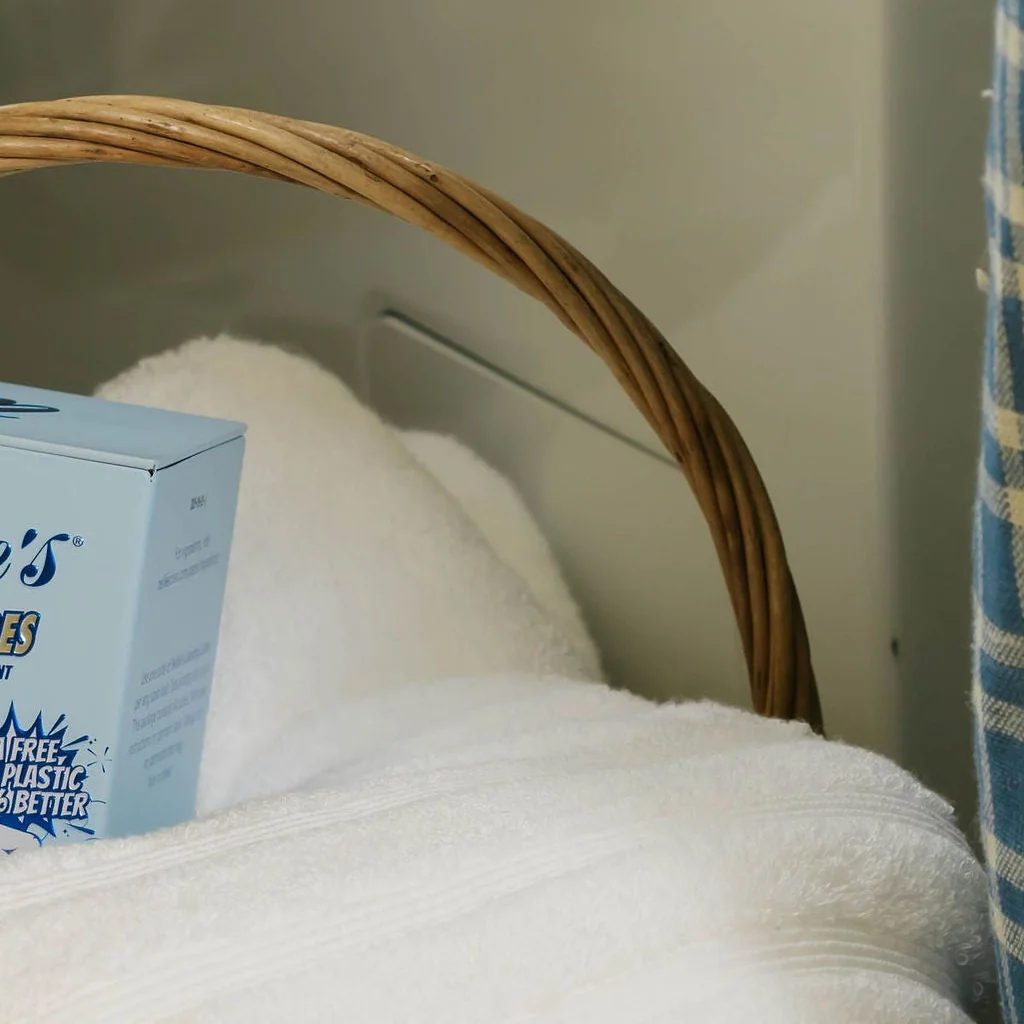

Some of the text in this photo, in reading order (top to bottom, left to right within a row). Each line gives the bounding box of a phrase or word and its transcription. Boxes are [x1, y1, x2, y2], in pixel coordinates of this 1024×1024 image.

[10, 737, 61, 763] FREE
[1, 764, 86, 791] PLASTIC
[13, 789, 90, 817] BETTER
